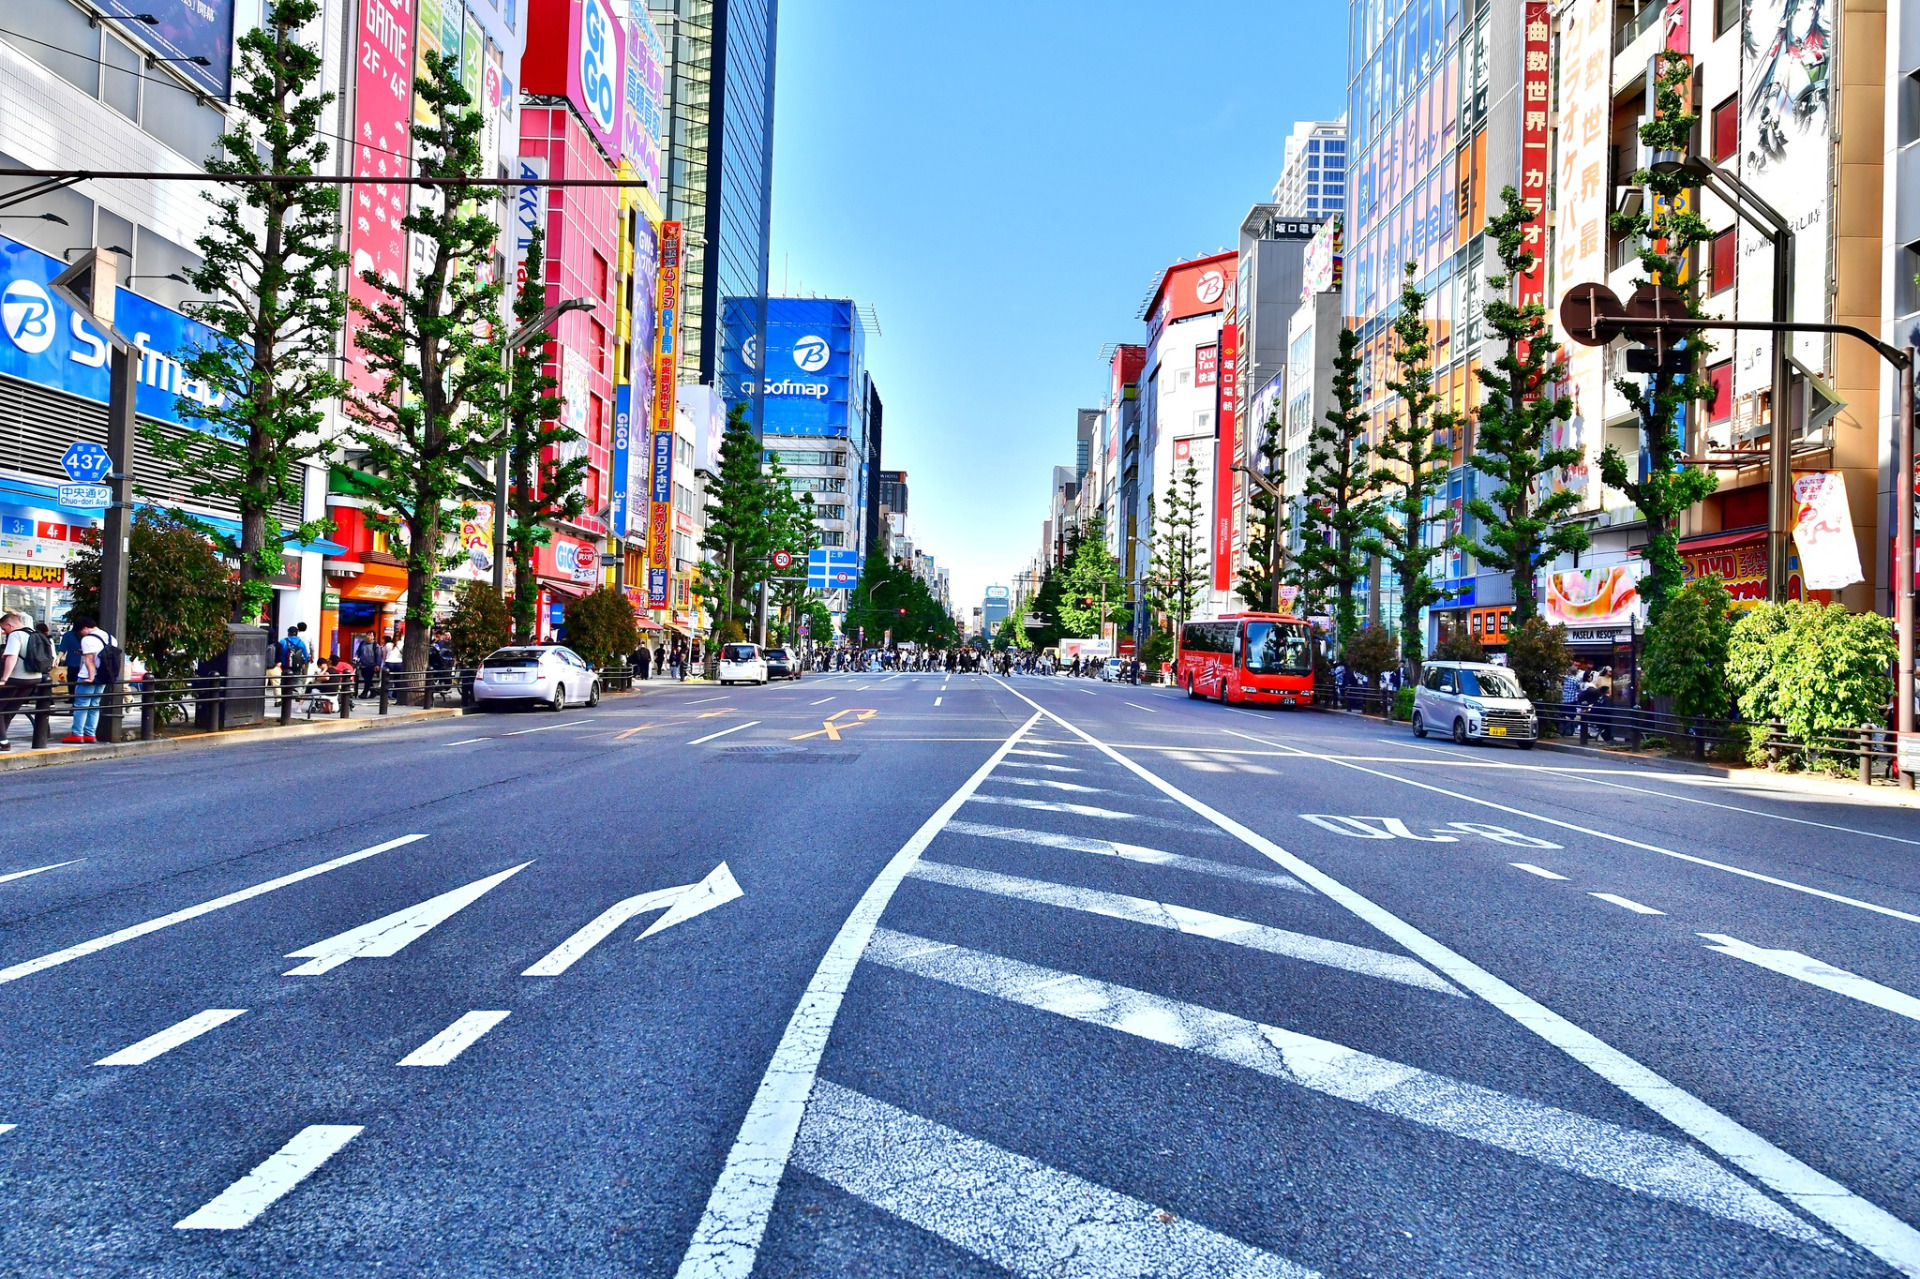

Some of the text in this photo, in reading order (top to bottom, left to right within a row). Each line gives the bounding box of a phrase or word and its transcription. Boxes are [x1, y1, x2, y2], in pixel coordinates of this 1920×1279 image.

[366, 0, 407, 68] GAME
[362, 41, 407, 102] 2F 4F
[1525, 21, 1548, 149] 曲数世界一
[663, 268, 675, 309] ムーラン
[1198, 361, 1214, 370] Tax
[658, 356, 672, 430] 中央通りホビー館
[763, 378, 829, 400] Sofmap
[1223, 360, 1235, 412] 坂口電熱
[616, 413, 629, 450] GiGO
[66, 453, 106, 470] 437
[60, 497, 94, 505] Chuo-dori
[62, 487, 108, 498] 中央通り
[13, 519, 25, 534] 3F
[47, 524, 59, 538] 4F
[557, 545, 578, 570] GiG
[777, 555, 788, 564] 50
[1697, 554, 1736, 579] DVD
[1573, 630, 1595, 640] PASELA
